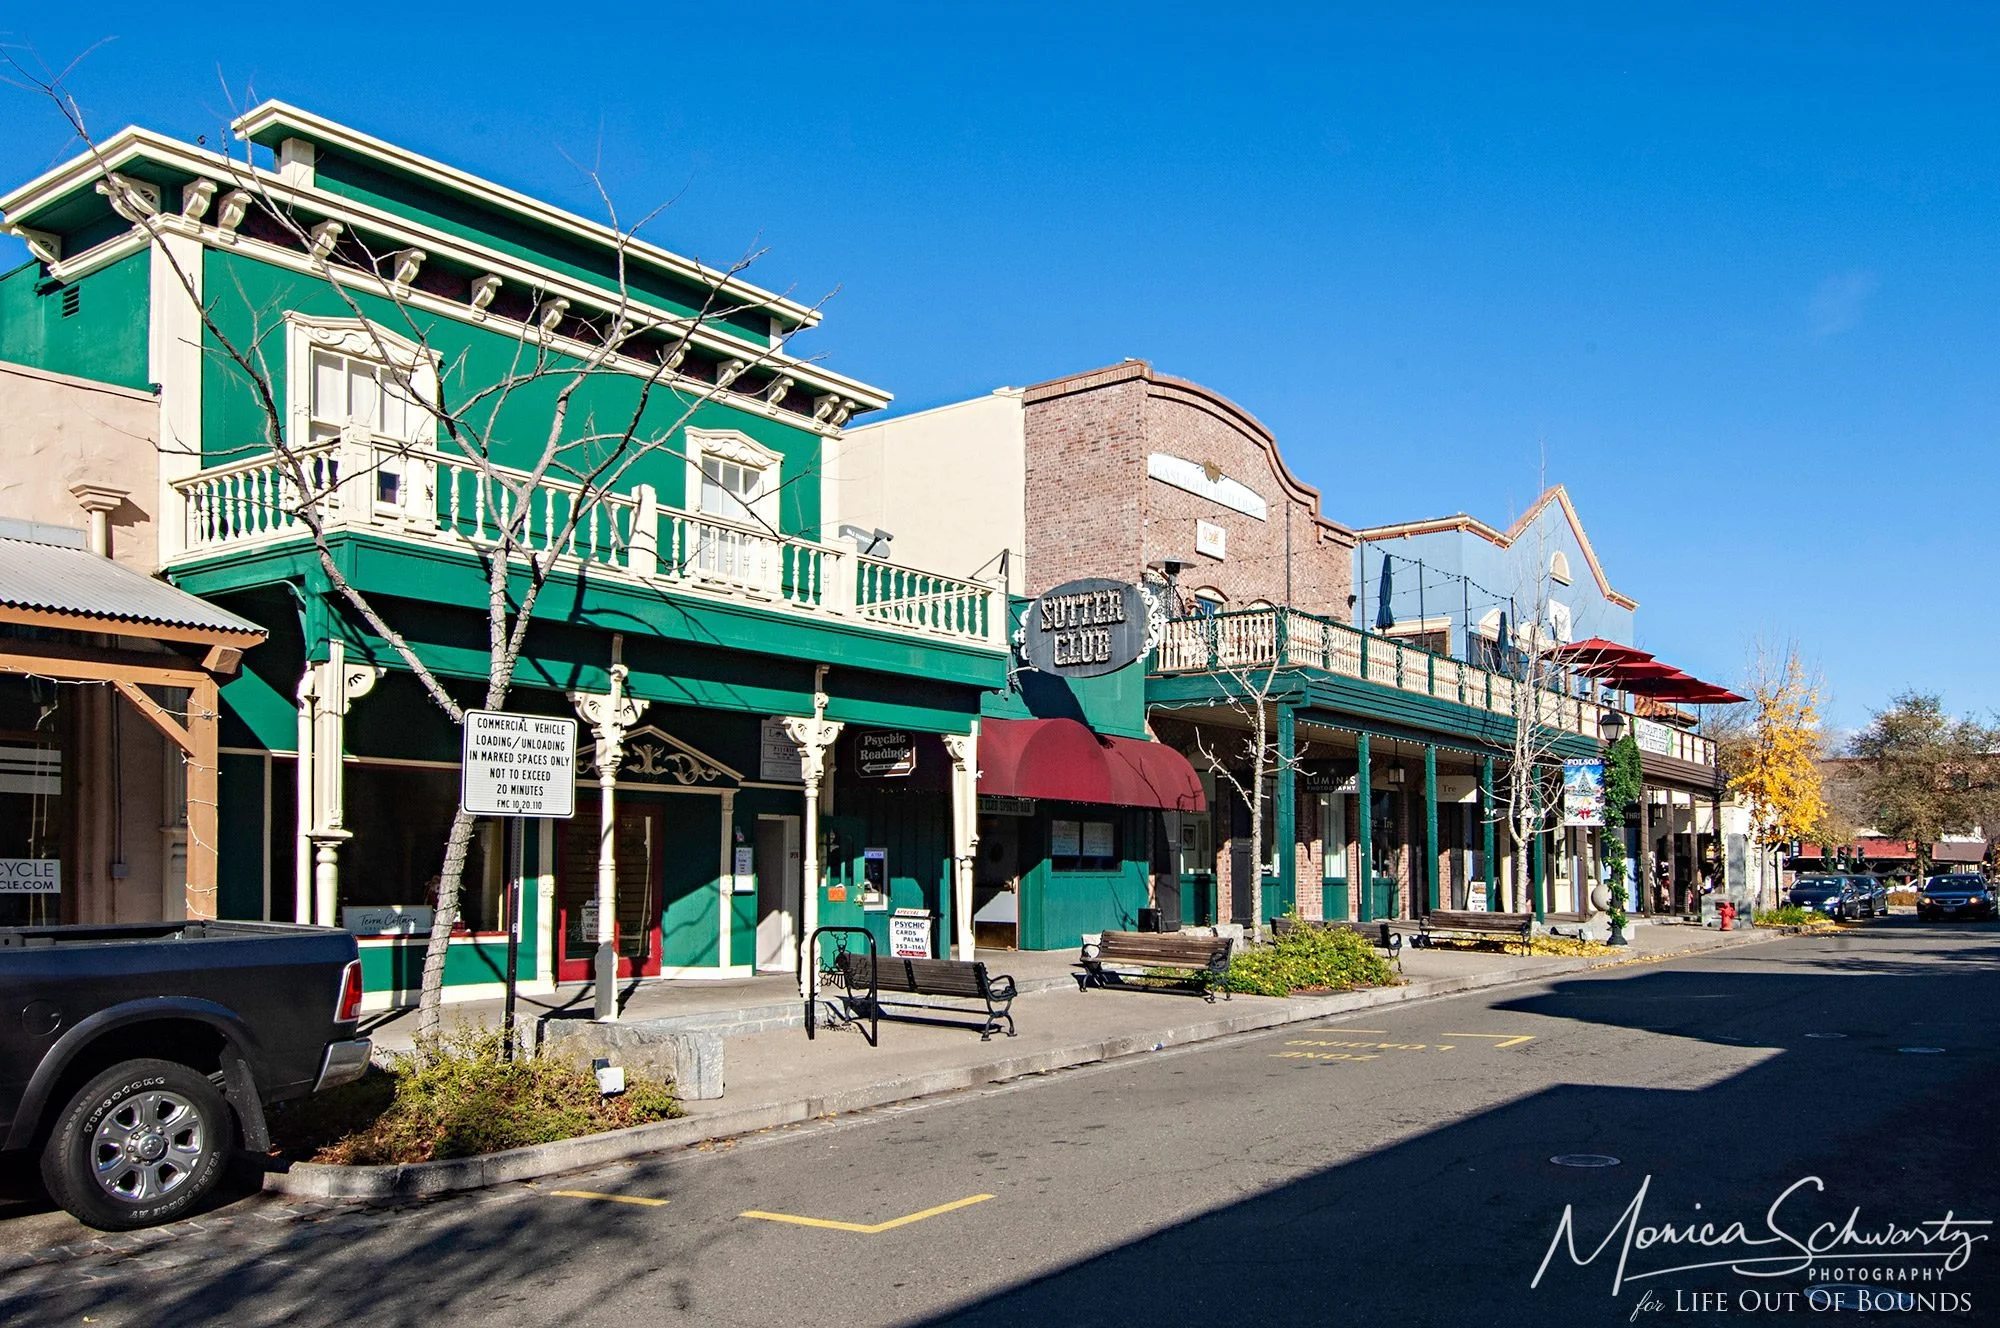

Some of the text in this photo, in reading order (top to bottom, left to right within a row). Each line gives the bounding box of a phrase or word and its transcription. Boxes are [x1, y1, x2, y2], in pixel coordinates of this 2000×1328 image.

[1041, 589, 1125, 632] SUTTER
[1054, 628, 1112, 666] CLUB
[477, 717, 566, 735] COMMERCIAL VEHICLE
[476, 735, 565, 751] LOADING/UNLOADING
[864, 733, 906, 747] Psychic
[469, 750, 570, 767] IN MARKED SPACES ONLY
[860, 748, 911, 761] Readings
[1567, 758, 1603, 766] FOLSOM
[490, 768, 551, 781] NOT TO EXCEED
[1306, 776, 1356, 785] LUMINIS
[497, 784, 544, 796] 20 MINUTES
[497, 799, 510, 808] FMC
[0, 862, 53, 877] YCLE
[895, 921, 925, 929] PSYCHIC
